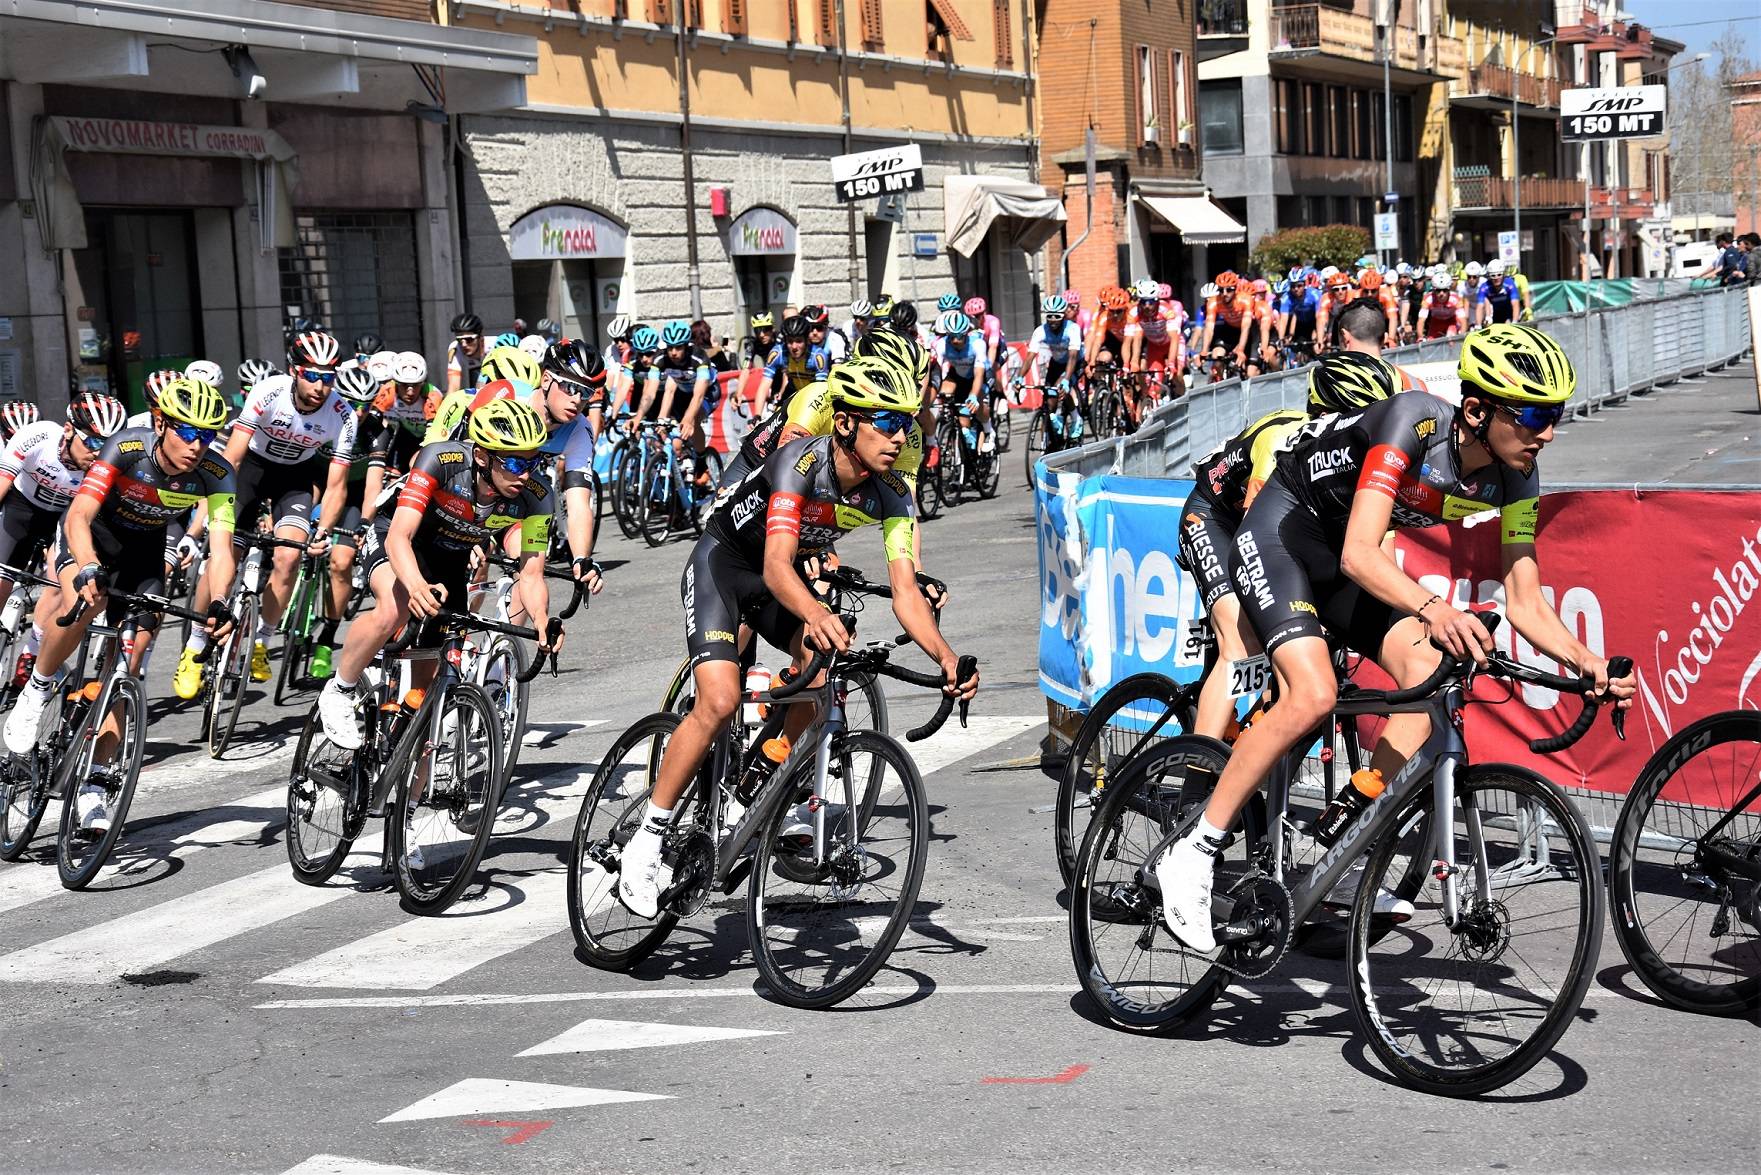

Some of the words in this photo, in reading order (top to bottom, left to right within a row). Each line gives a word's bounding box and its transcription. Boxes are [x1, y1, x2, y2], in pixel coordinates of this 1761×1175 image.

[1580, 98, 1644, 112] SMP
[67, 120, 199, 149] NOVOMARKET
[206, 133, 266, 153] CORRADINI
[1570, 116, 1612, 134] 150
[1619, 114, 1655, 132] MT
[851, 158, 903, 176] SMP
[844, 178, 880, 197] 150
[885, 171, 915, 191] MT
[264, 427, 321, 447] ARKEA
[271, 420, 291, 429] BH
[36, 467, 57, 480] BH
[1308, 446, 1353, 482] TRUCK
[1333, 462, 1357, 475] ITALIA
[731, 490, 764, 530] TRUCK
[1188, 521, 1224, 582] BIESSE
[1237, 531, 1275, 611] BELTRAMI
[685, 563, 697, 638] BELTRAMI
[1184, 622, 1206, 659] 191
[1232, 663, 1264, 695] 215
[1310, 782, 1395, 889] ARGON
[1396, 755, 1421, 784] 18
